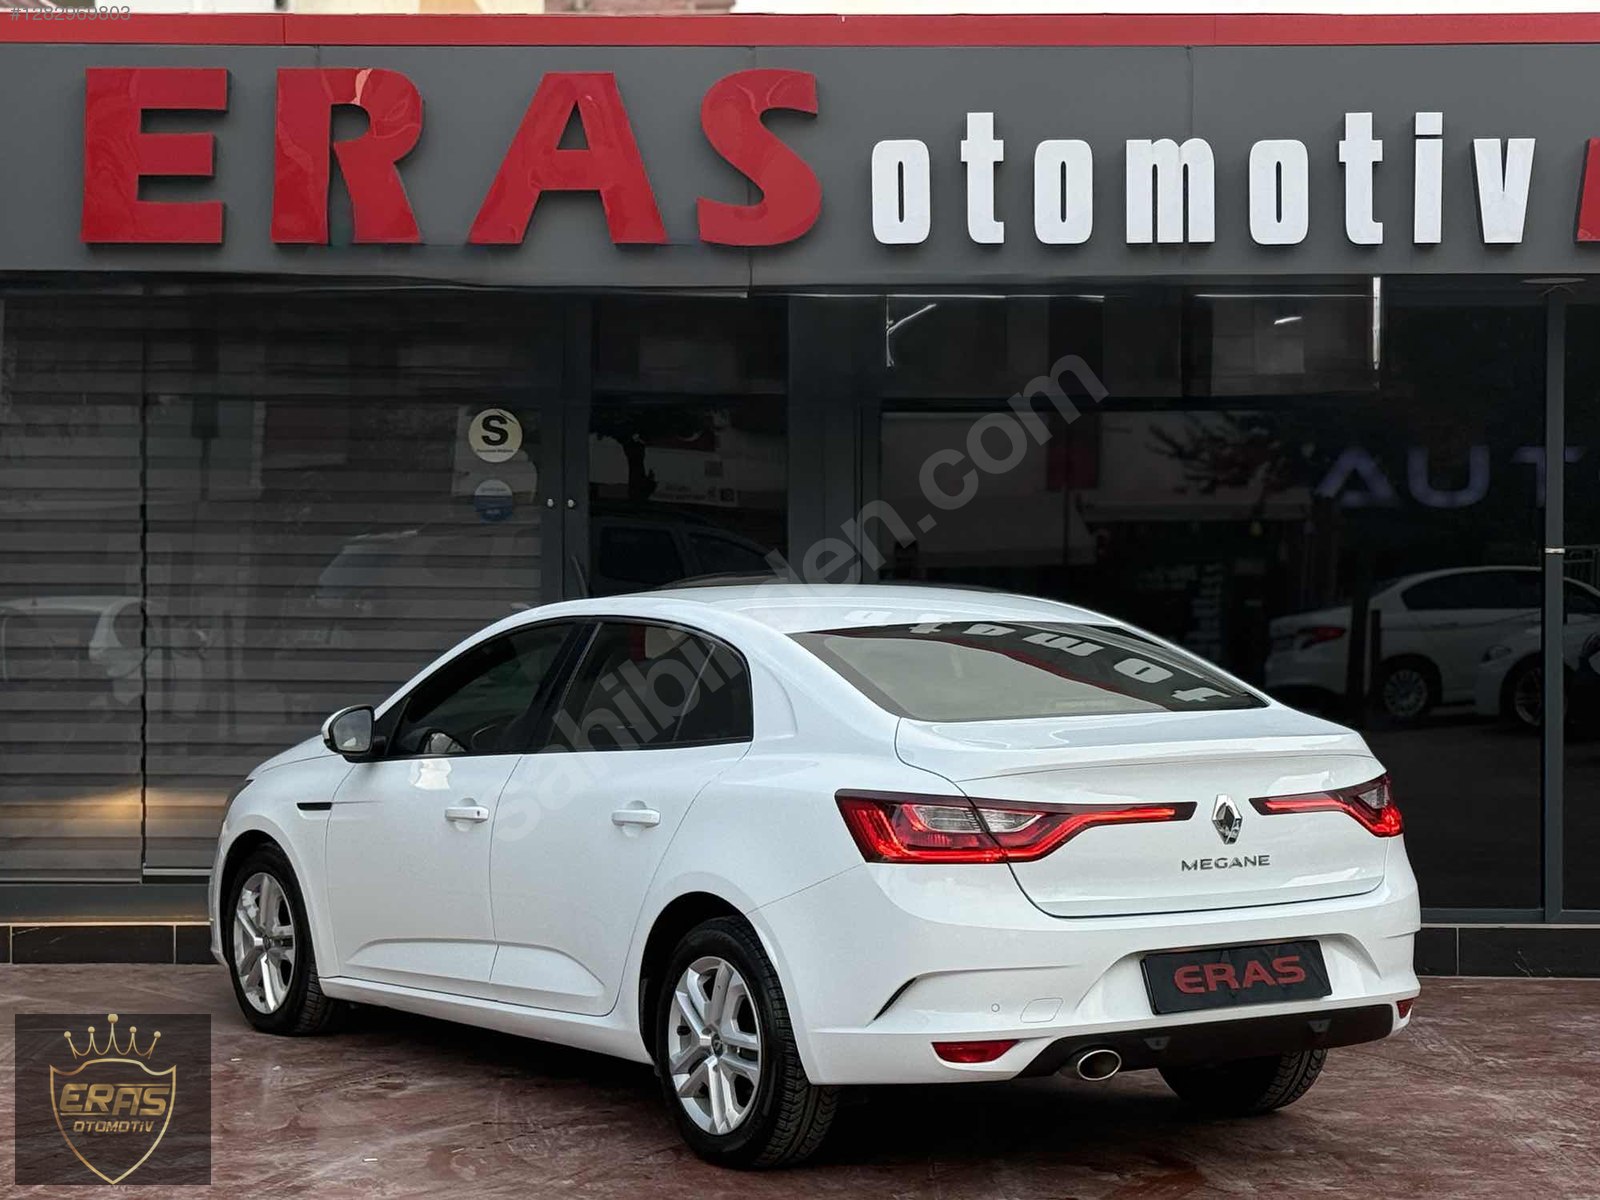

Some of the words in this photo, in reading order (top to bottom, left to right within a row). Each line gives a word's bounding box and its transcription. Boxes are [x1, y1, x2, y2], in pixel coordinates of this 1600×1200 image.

[81, 67, 823, 246] ERAS
[871, 111, 1536, 245] otomotiv
[481, 414, 509, 446] S
[1181, 854, 1271, 872] MEGANE
[1174, 955, 1306, 995] ERAS
